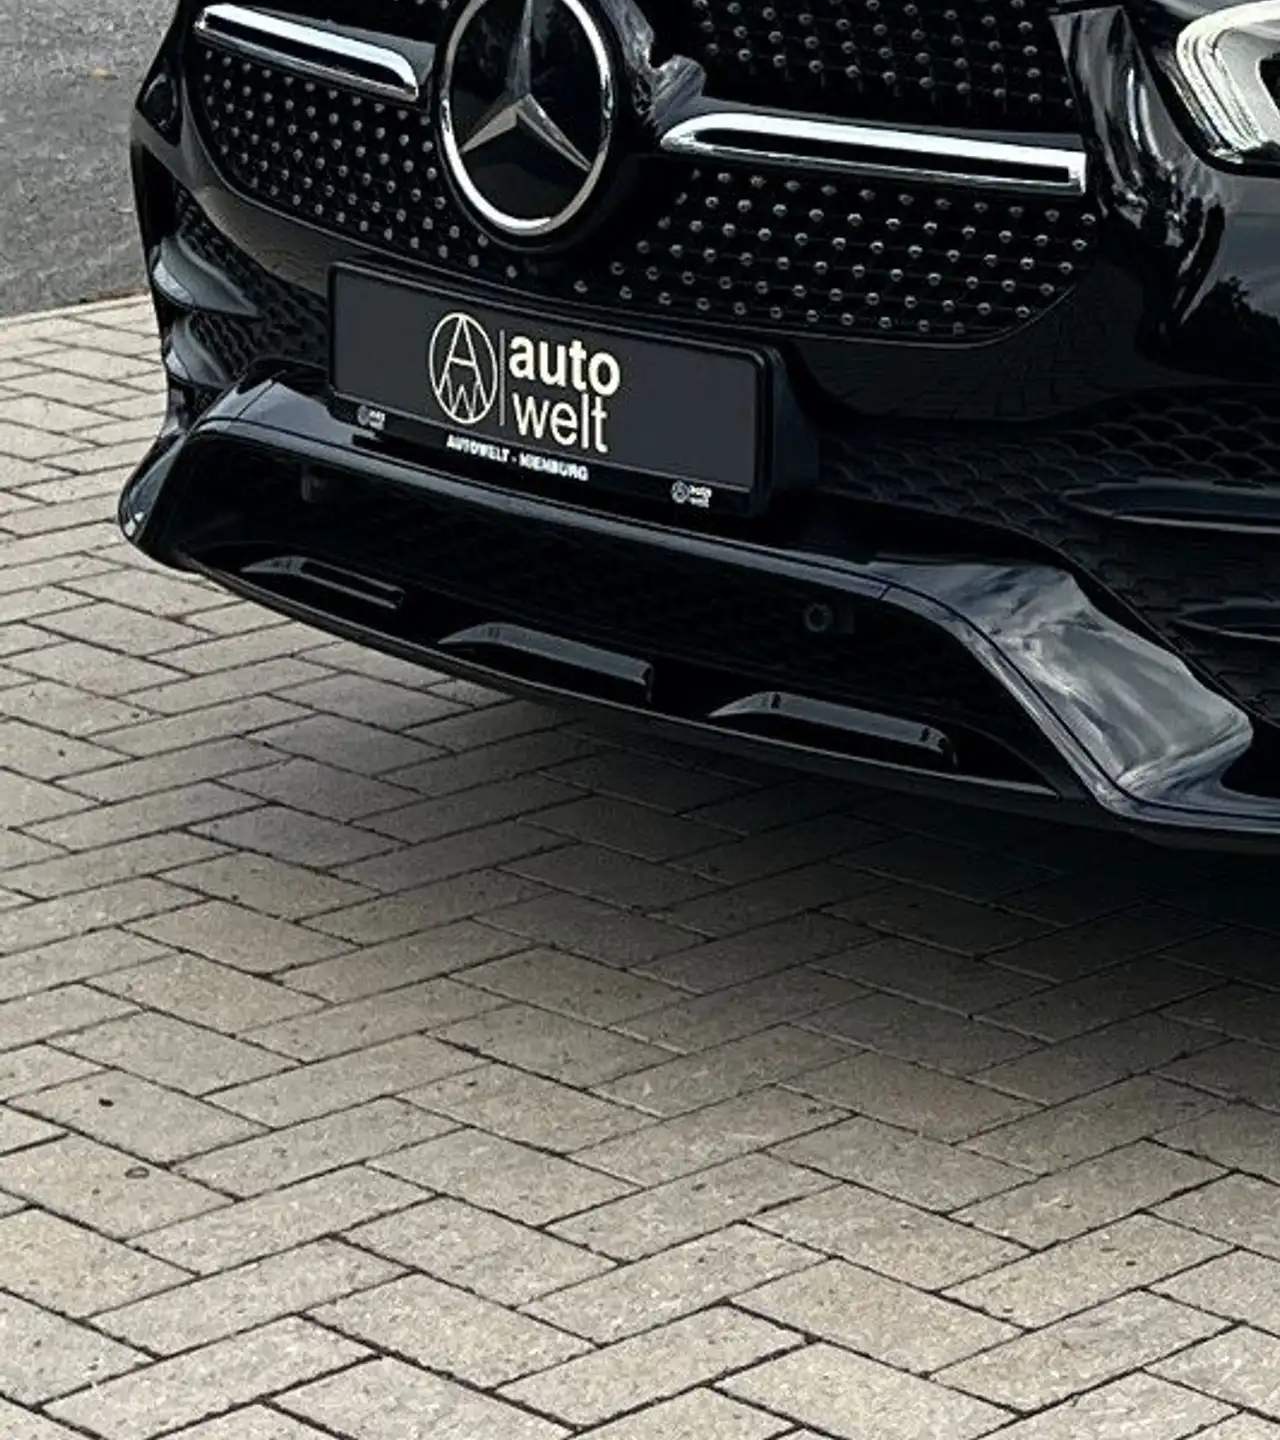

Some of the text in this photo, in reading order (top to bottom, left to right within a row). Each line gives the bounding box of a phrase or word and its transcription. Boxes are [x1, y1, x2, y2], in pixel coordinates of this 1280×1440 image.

[508, 335, 621, 397] auto
[446, 433, 511, 463] AUTOWELT
[511, 392, 609, 453] welt
